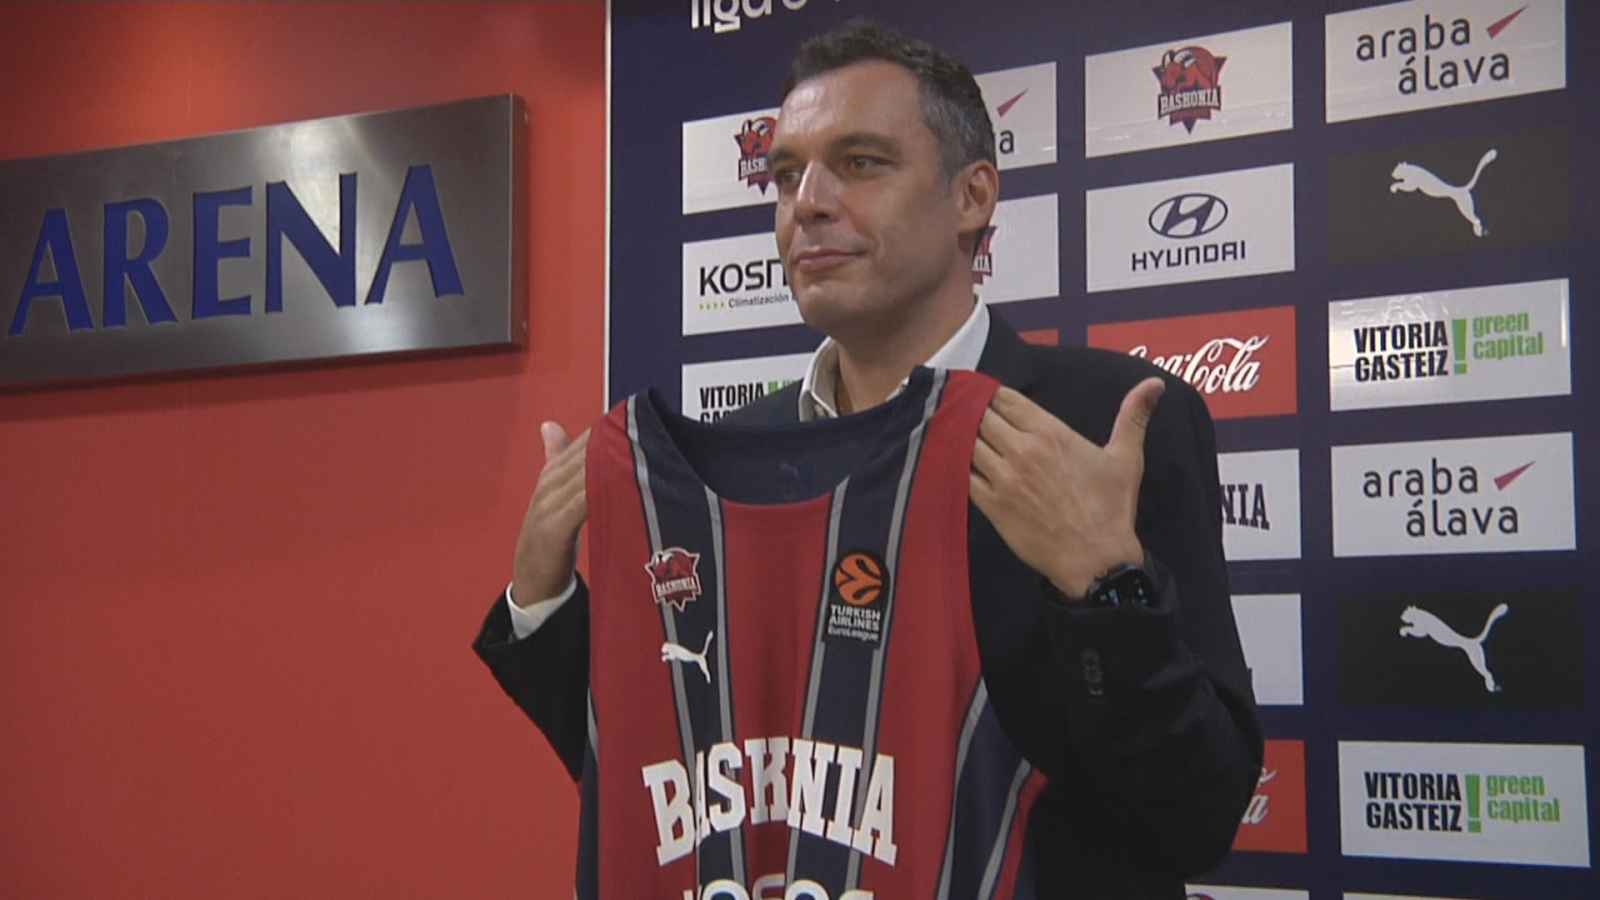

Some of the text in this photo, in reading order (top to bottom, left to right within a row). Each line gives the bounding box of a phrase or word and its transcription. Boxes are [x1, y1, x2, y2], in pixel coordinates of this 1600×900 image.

[1356, 14, 1470, 61] araba
[1398, 53, 1510, 95] álava
[8, 164, 465, 337] ARENA
[1132, 240, 1246, 271] HYUNDAI
[1354, 320, 1449, 353] VITORIA
[1472, 313, 1530, 338] green
[1473, 332, 1545, 360] capital
[1355, 350, 1449, 382] GASTEIZ
[1363, 457, 1478, 498] araba
[1406, 499, 1519, 537] álava
[829, 614, 880, 631] AIRLINES
[830, 604, 881, 621] TURKISH
[1364, 772, 1461, 801] VITORIA
[1486, 775, 1546, 798] green
[1366, 801, 1462, 832] GASTEIZ
[1487, 797, 1561, 823] capital
